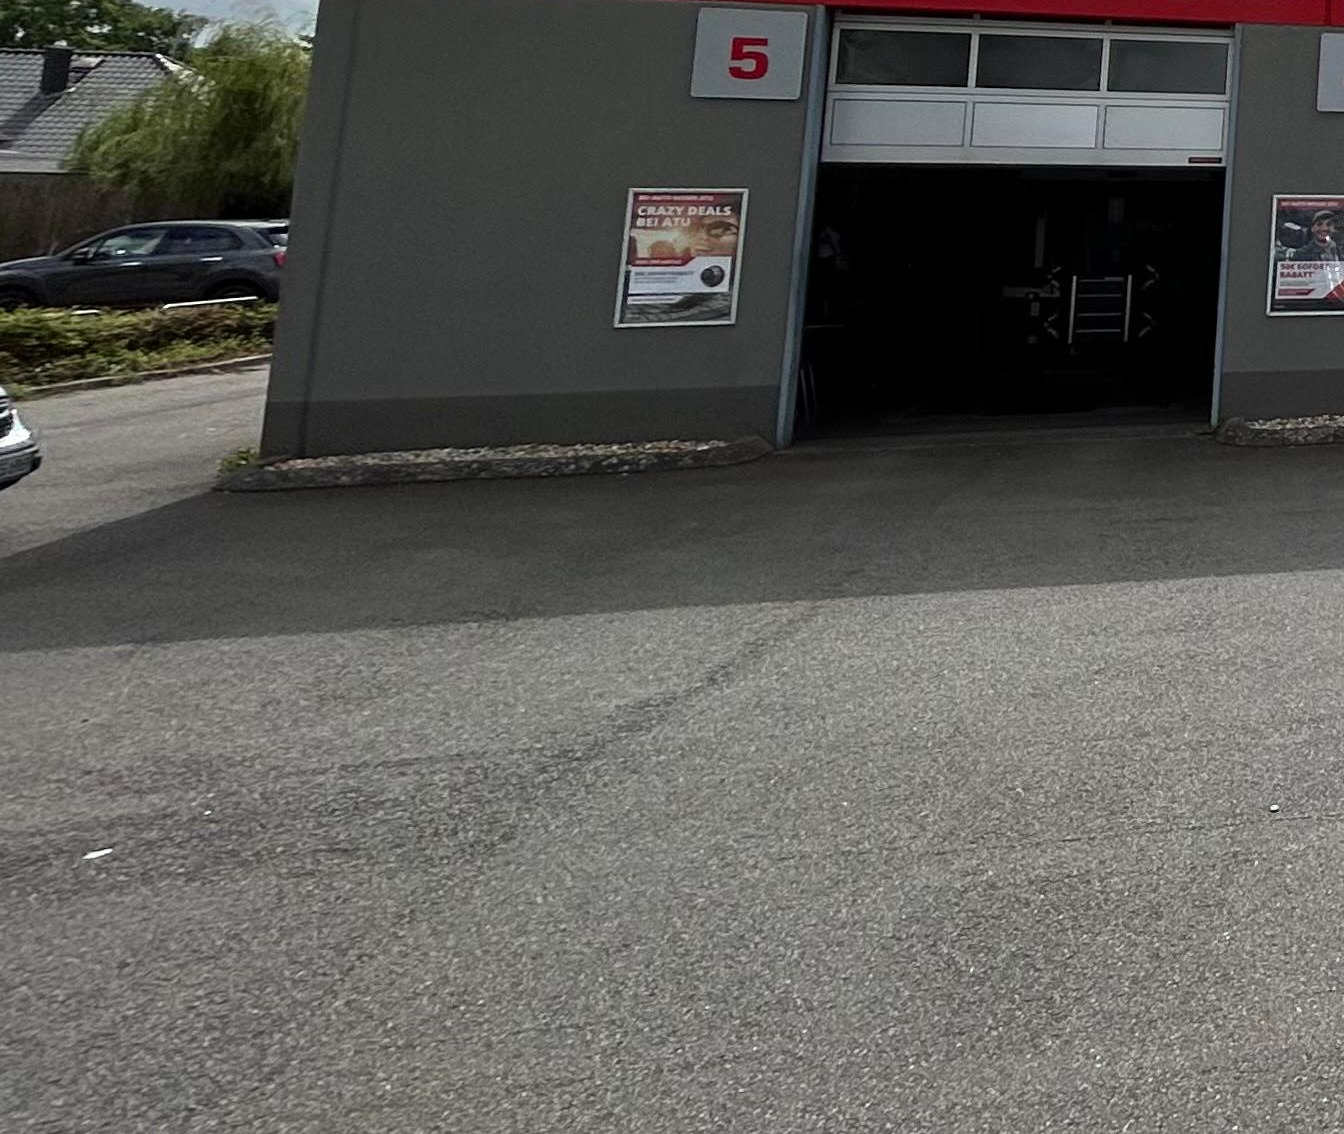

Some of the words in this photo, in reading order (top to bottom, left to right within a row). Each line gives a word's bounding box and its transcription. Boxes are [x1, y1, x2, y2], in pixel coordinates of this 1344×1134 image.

[728, 37, 769, 80] 5
[637, 206, 683, 216] CRAZY
[688, 205, 732, 216] DEALS
[636, 217, 659, 227] BEI
[662, 217, 691, 227] ATU
